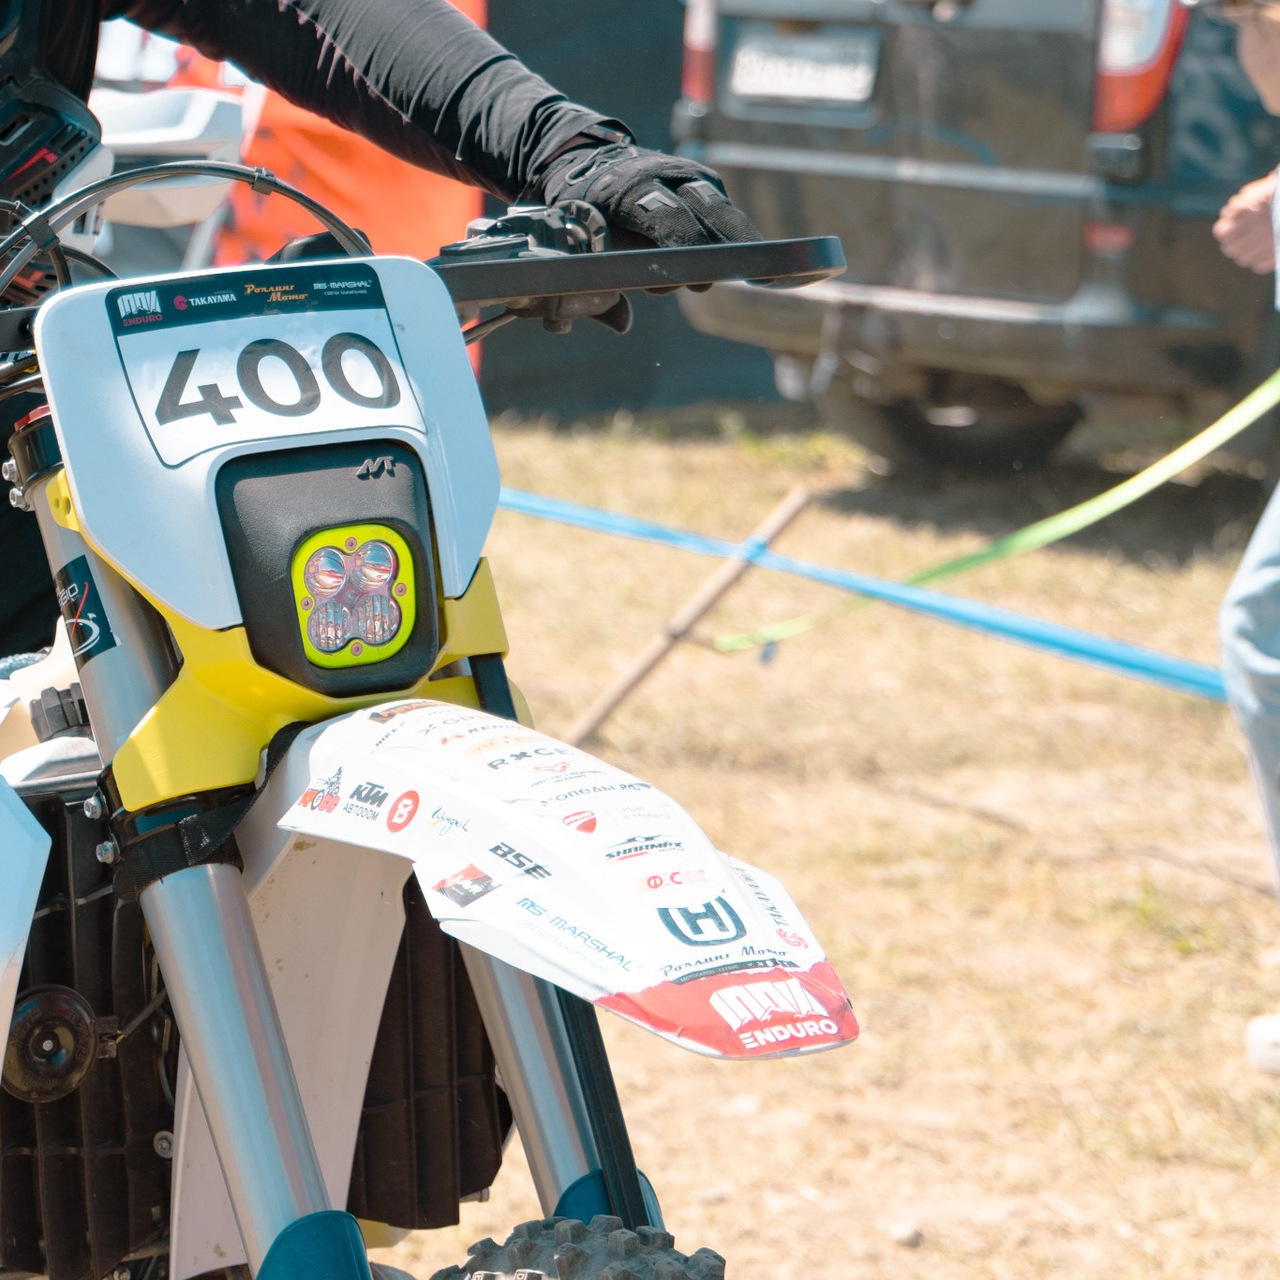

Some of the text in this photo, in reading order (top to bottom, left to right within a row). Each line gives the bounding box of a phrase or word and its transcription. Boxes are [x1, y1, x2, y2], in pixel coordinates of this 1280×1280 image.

[189, 292, 237, 307] TAKAYAMA
[244, 283, 295, 295] Роллинг
[267, 292, 308, 303] Мото
[123, 314, 163, 327] ENDURO
[155, 332, 401, 426] 400
[349, 781, 389, 808] KTM
[342, 803, 379, 821] АВТОДОМ
[605, 841, 683, 859] SHARMAX
[488, 842, 553, 880] BSE
[515, 897, 633, 972] MS-MARSHAL
[660, 953, 730, 977] Роллинг
[739, 1019, 839, 1049] ENDURO
